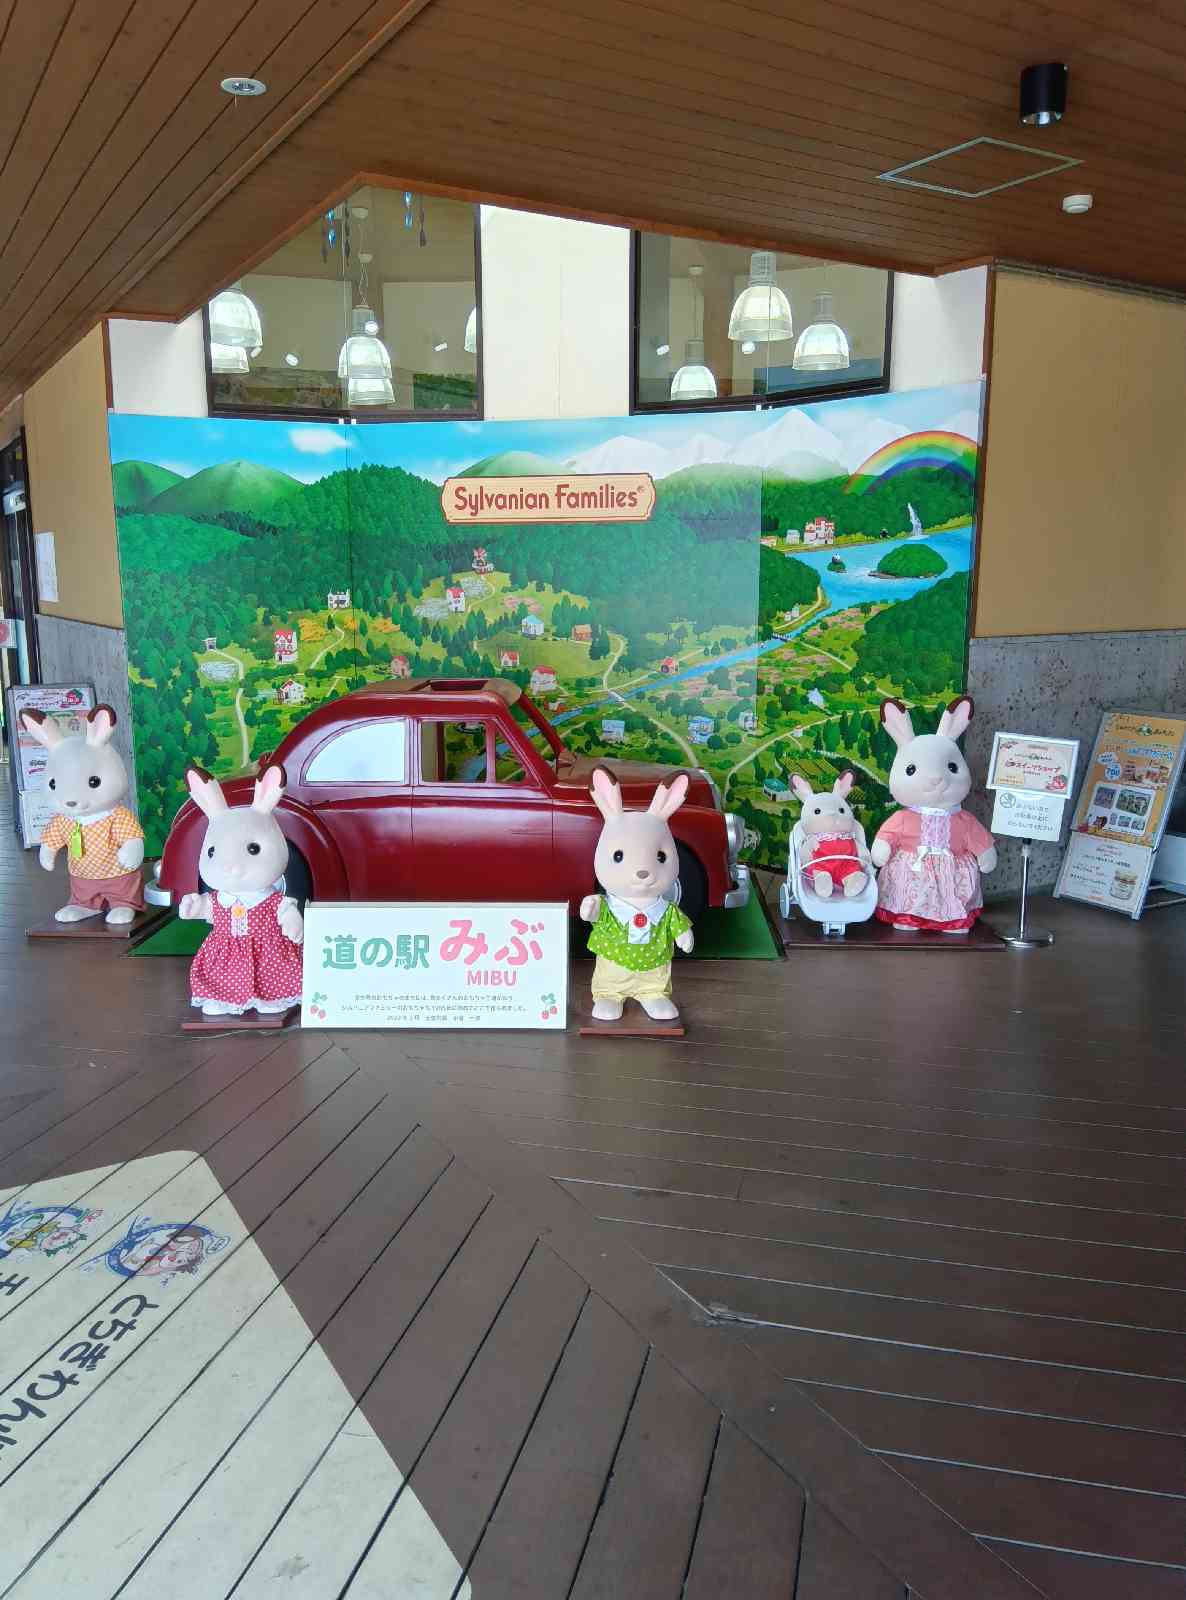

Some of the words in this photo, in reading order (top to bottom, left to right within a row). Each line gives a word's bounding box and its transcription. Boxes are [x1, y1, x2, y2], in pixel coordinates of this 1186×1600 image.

[454, 485, 549, 516] Sylvanian
[555, 483, 638, 510] Families
[322, 934, 430, 970] 道の駅
[439, 918, 545, 966] みぶ
[466, 970, 517, 986] MIBU
[0, 1294, 159, 1447] とちぎわん
